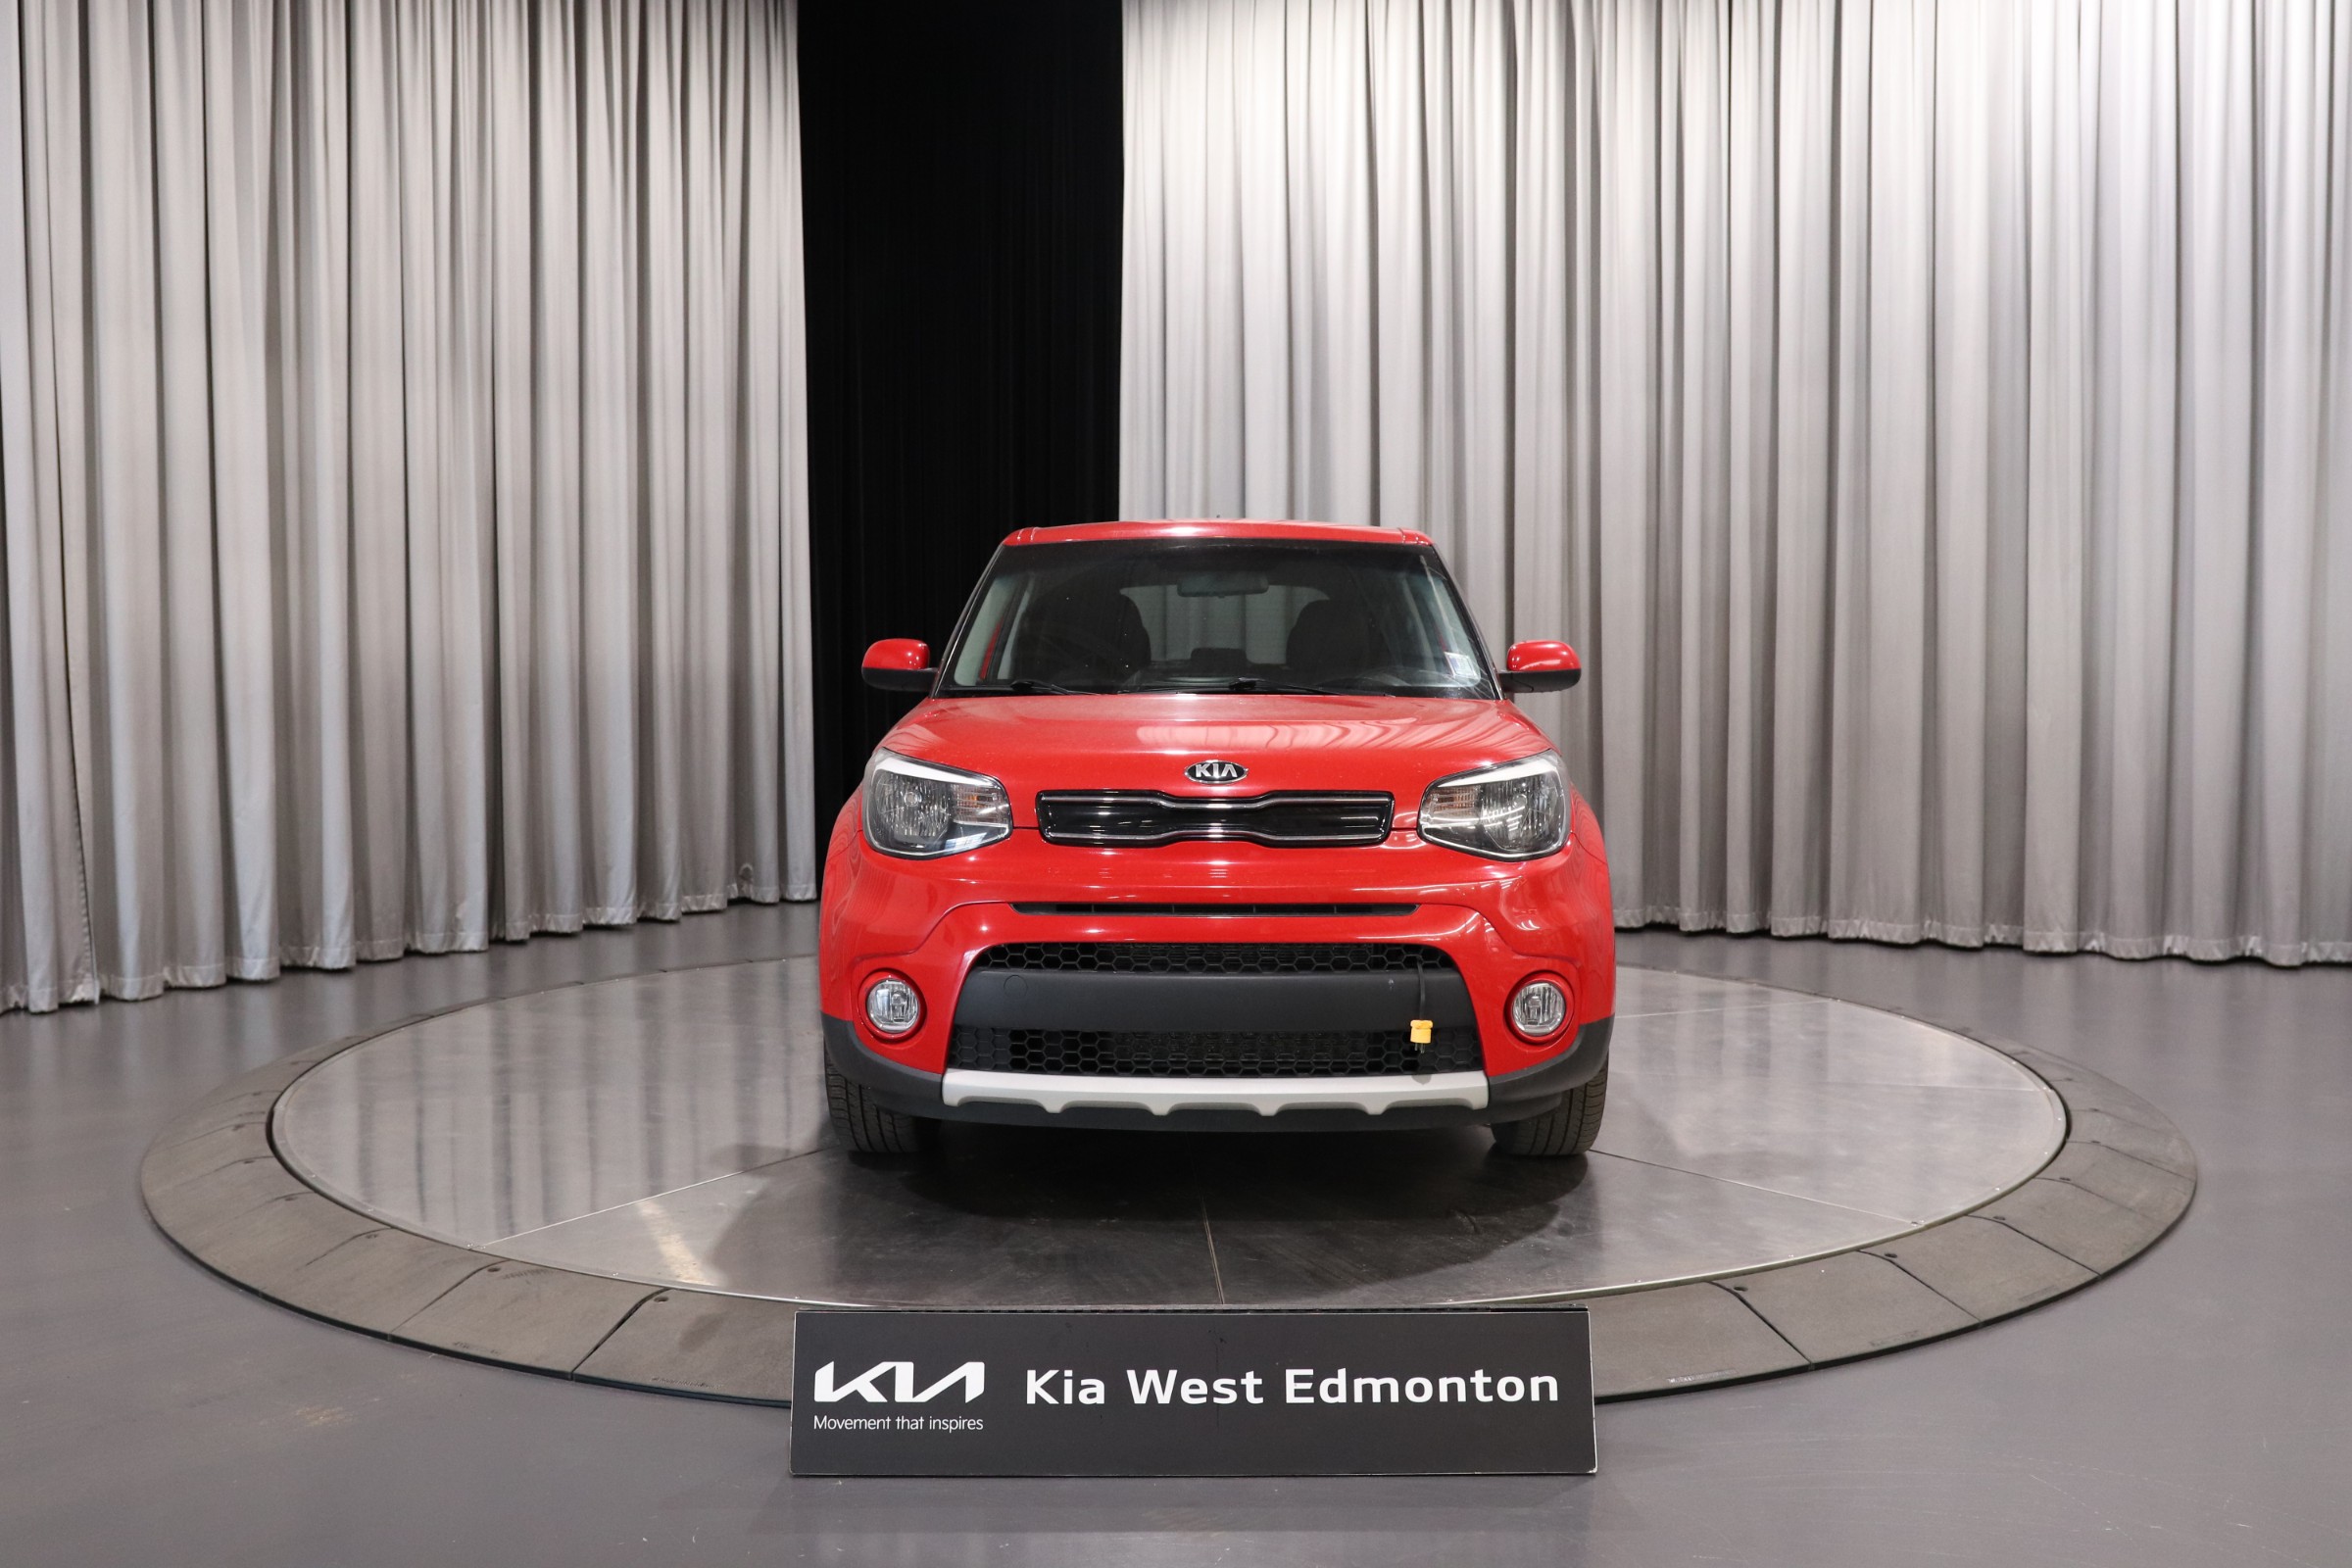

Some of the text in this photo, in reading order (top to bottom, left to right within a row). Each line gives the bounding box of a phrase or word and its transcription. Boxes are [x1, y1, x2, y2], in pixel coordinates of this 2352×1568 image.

[1196, 763, 1238, 778] KIA
[1026, 1368, 1559, 1405] Kia West Edmonton
[813, 1414, 984, 1434] Movement that inspires
